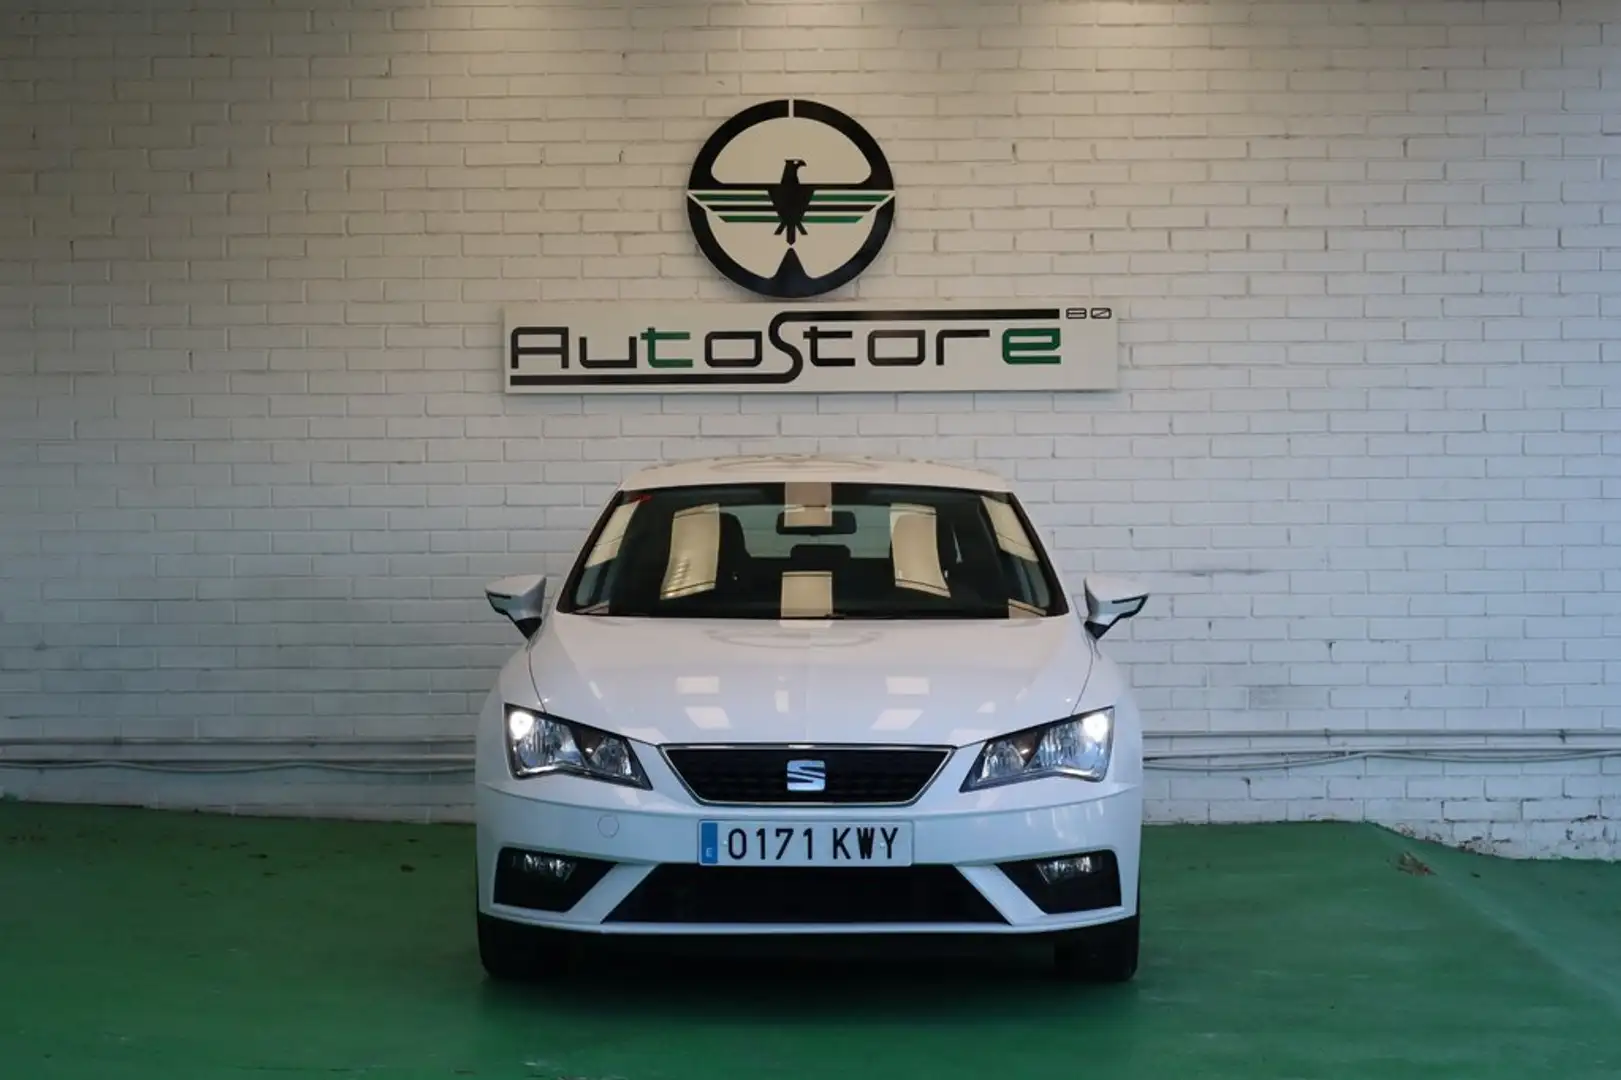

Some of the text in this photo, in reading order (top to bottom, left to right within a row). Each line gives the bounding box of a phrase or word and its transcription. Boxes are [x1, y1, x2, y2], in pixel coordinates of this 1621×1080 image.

[1066, 308, 1112, 319] 80
[728, 827, 814, 860] 0171
[832, 827, 899, 860] KWY
